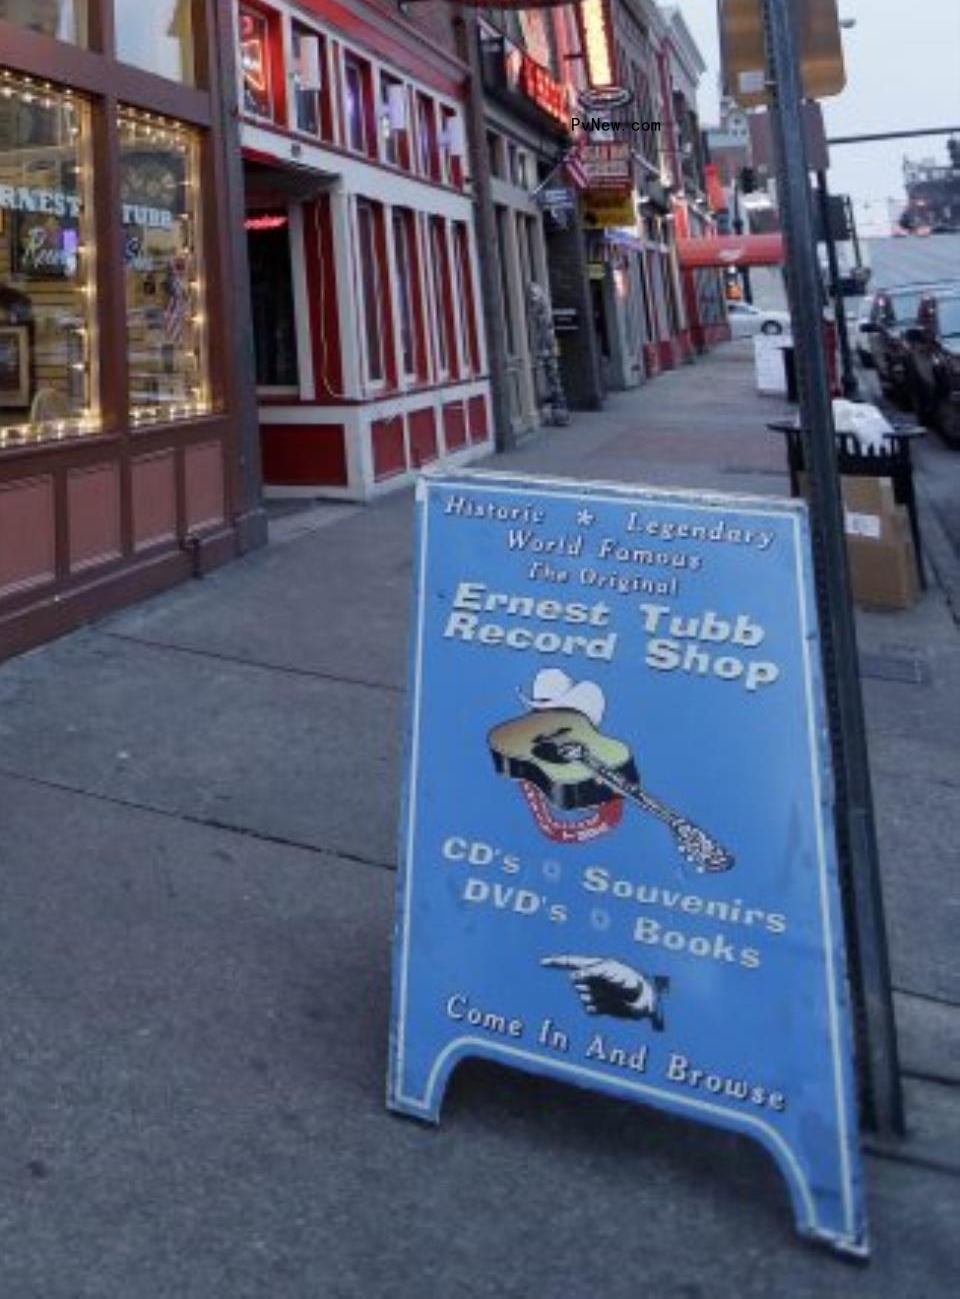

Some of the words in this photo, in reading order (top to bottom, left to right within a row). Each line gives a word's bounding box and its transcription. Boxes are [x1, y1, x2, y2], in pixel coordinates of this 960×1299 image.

[122, 204, 172, 230] TUBB
[443, 494, 545, 526] Historic
[626, 511, 776, 550] Legendary
[507, 529, 583, 558] World
[597, 538, 704, 571] Famous
[527, 561, 570, 586] The
[579, 567, 680, 598] Original
[451, 581, 612, 628] Ernest
[639, 603, 767, 648] Tubb
[442, 611, 618, 664] Record
[643, 638, 781, 693] Shop
[442, 836, 521, 876] CD's
[582, 865, 788, 934] Souvenirs
[463, 877, 569, 923] DVD's
[632, 916, 762, 970] Books
[445, 994, 526, 1039] Come
[538, 1018, 570, 1052] In
[585, 1032, 649, 1075] And
[665, 1052, 788, 1113] Browse
